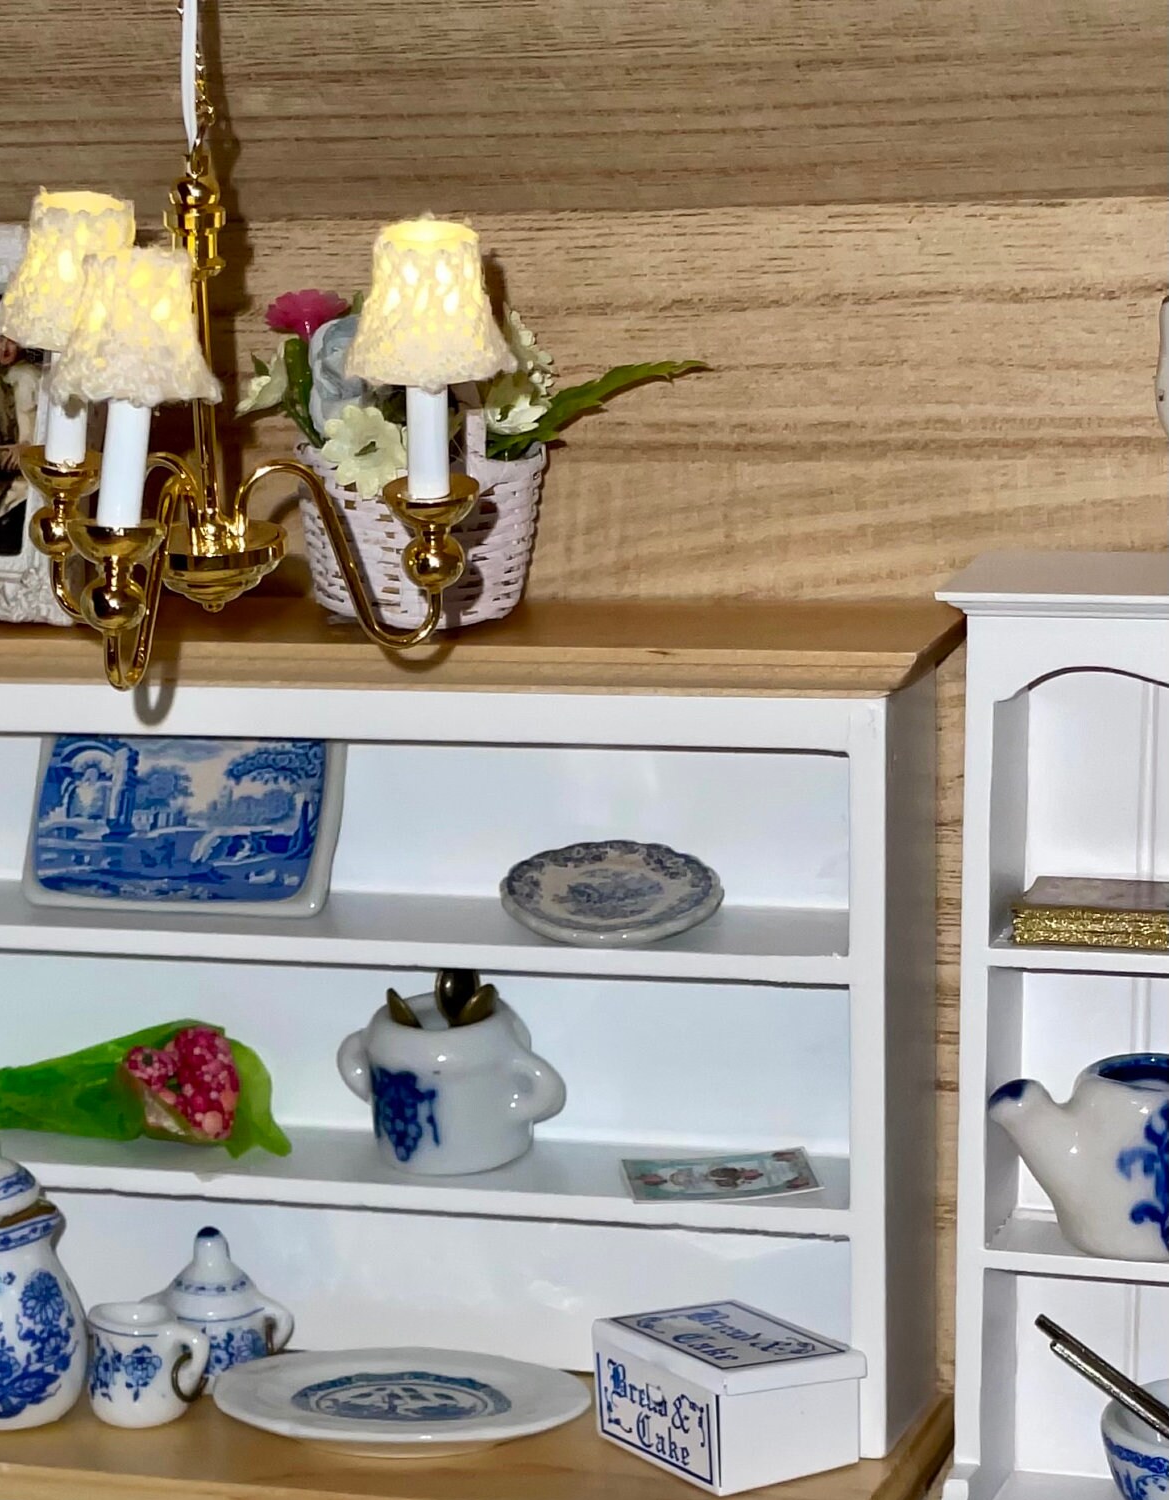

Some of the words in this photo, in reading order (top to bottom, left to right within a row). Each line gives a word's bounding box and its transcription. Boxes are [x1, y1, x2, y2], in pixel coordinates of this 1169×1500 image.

[671, 1332, 739, 1361] Cake
[672, 1394, 690, 1433] &
[636, 1410, 690, 1466] Cake
